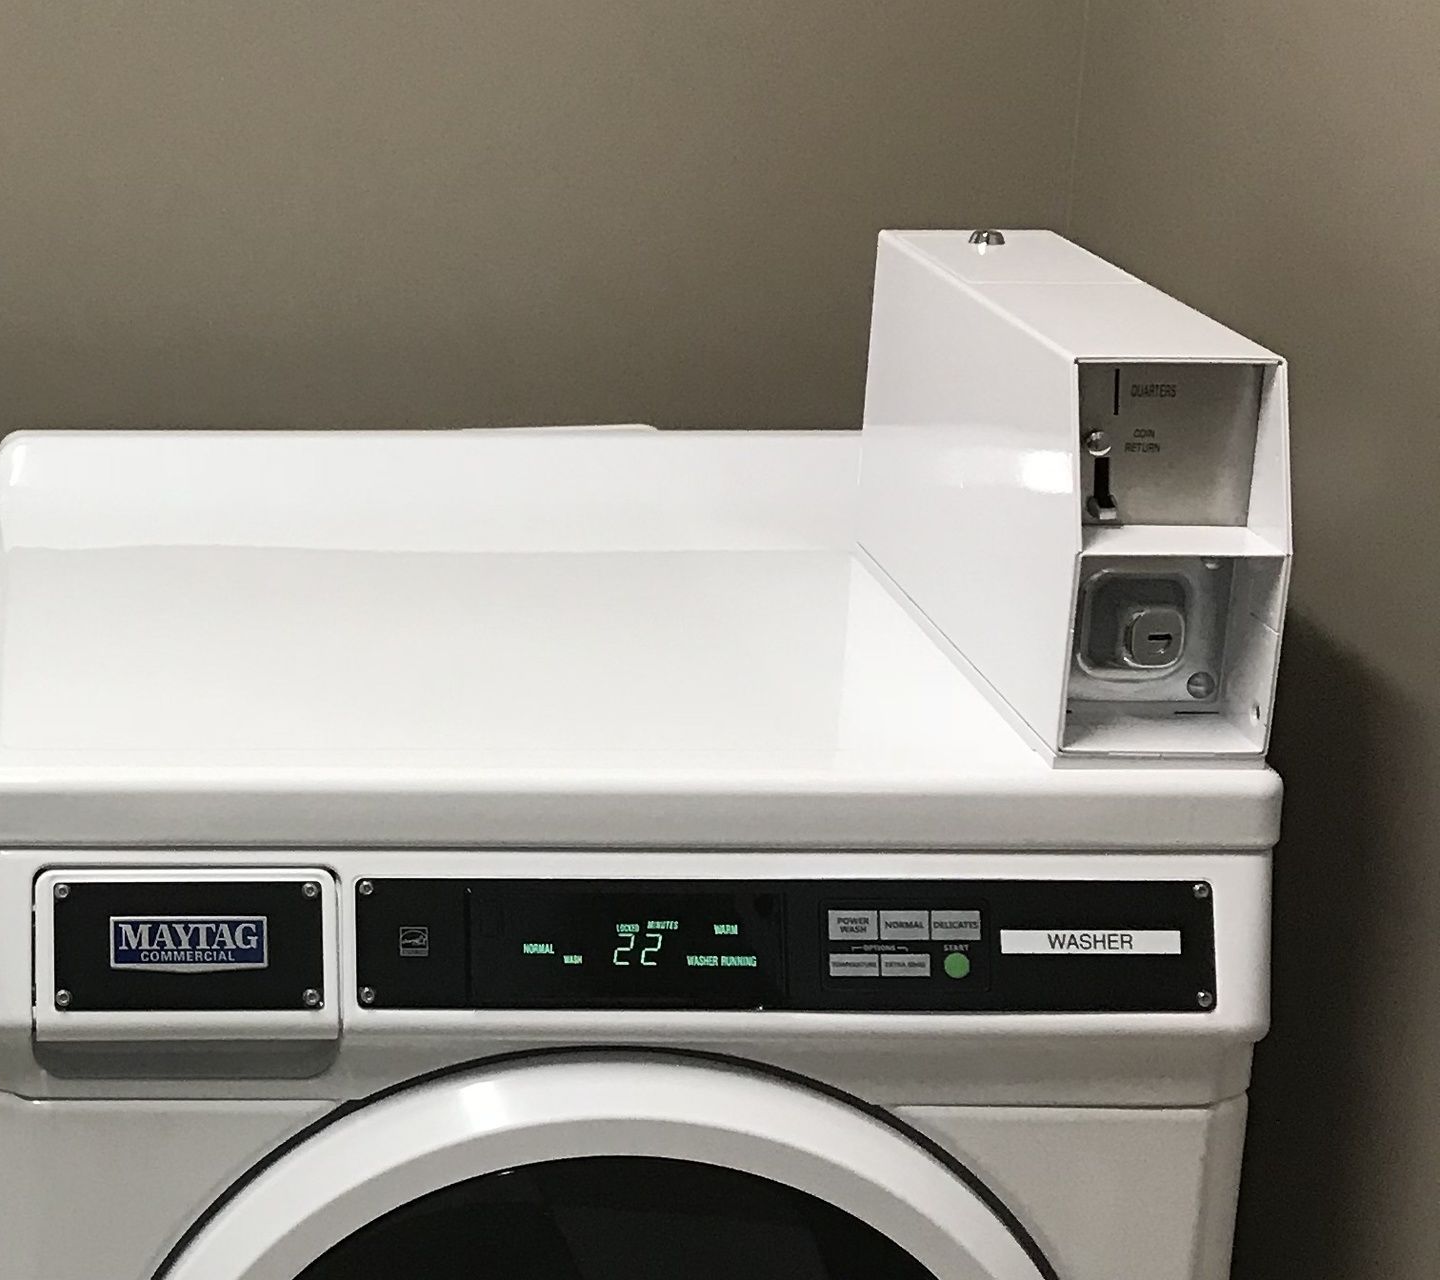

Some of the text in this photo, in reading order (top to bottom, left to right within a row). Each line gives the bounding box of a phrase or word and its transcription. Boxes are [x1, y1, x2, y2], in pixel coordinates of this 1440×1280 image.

[1130, 384, 1176, 398] QUARTERS
[647, 920, 679, 930] MINUTES
[837, 917, 870, 926] POWER
[885, 920, 925, 930] NORMAL
[933, 921, 979, 930] DELICATES
[616, 923, 640, 933] LOCKED
[714, 924, 738, 935] WARM
[840, 925, 868, 934] WASH
[118, 923, 259, 950] MAYTAG
[1047, 933, 1133, 950] WASHER
[523, 943, 555, 955] NORMAL
[613, 933, 663, 966] 22
[943, 944, 970, 952] START
[140, 951, 236, 962] COMMERCIAL
[563, 954, 583, 964] WASH
[686, 955, 757, 967] WASHER RUNNING
